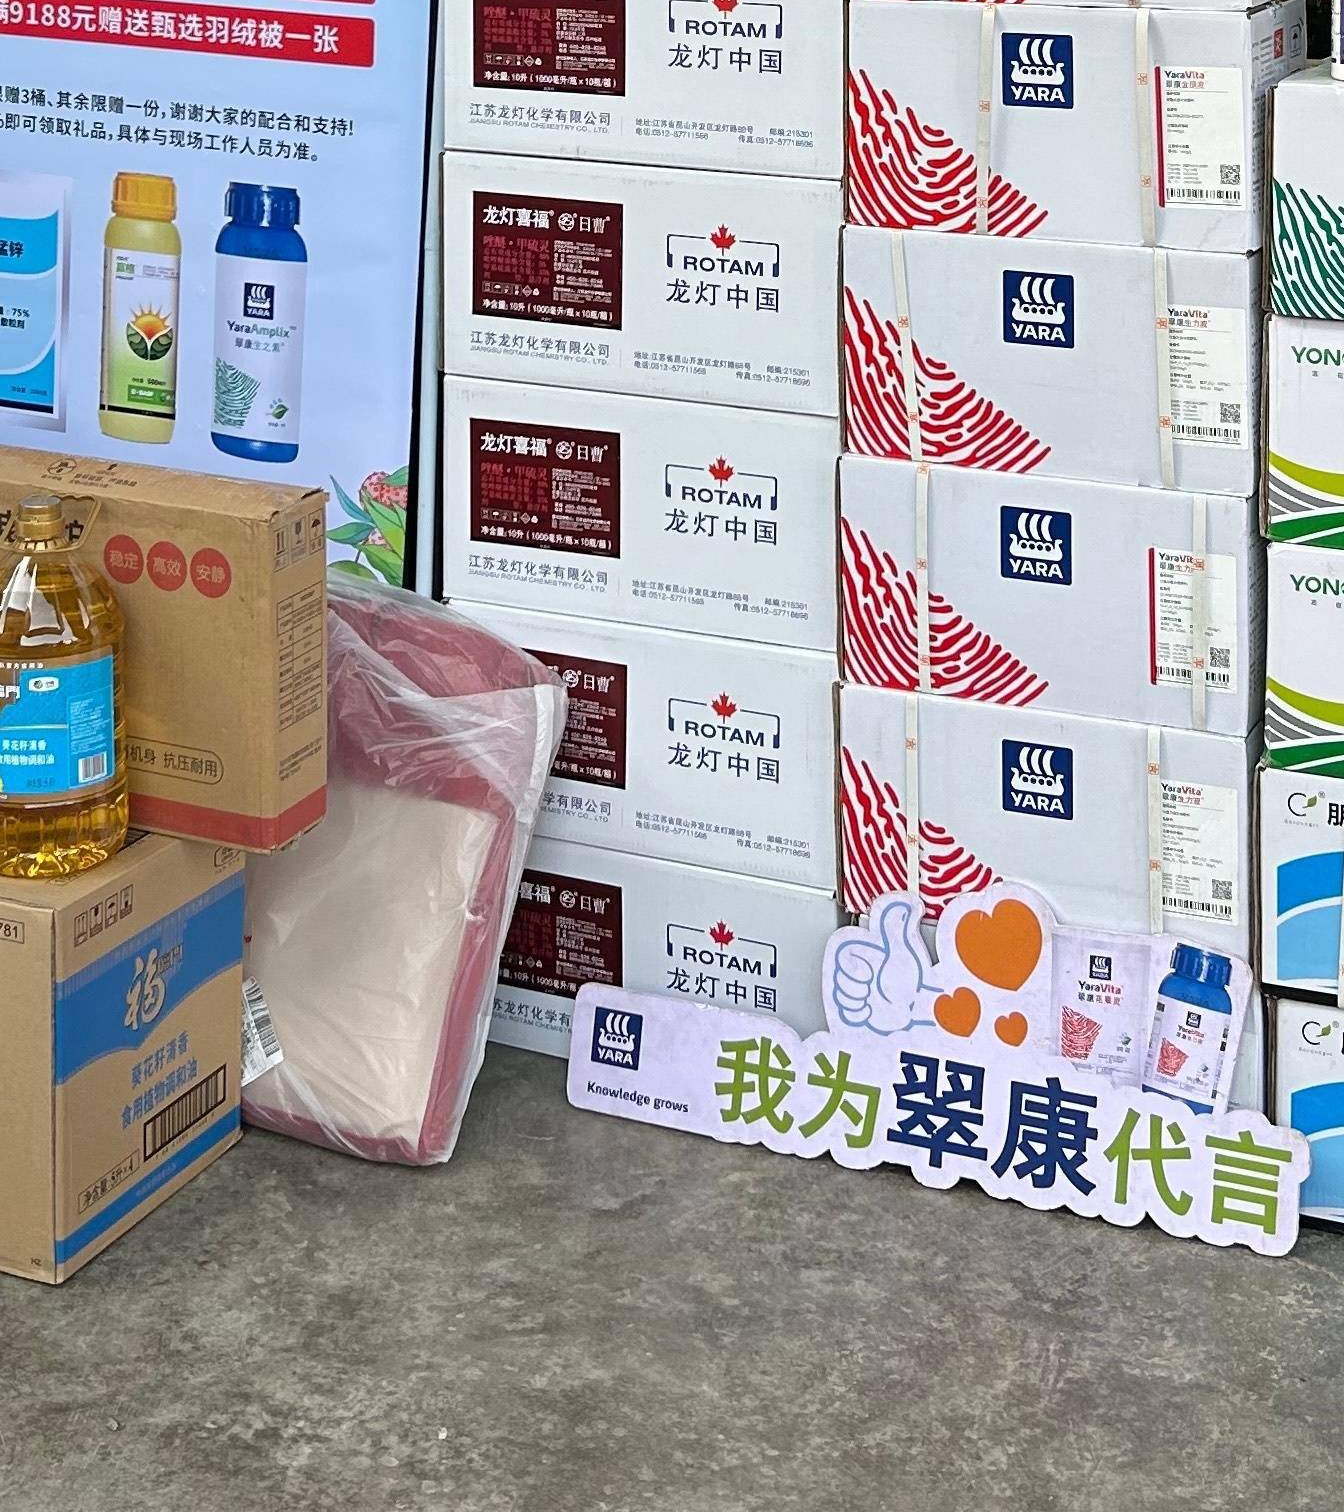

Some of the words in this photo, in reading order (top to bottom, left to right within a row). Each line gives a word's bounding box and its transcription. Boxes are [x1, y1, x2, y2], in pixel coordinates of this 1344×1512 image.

[685, 19, 767, 39] ROTAM
[668, 43, 783, 74] 龙灯中国
[1164, 70, 1205, 81] YaraVita
[1010, 85, 1064, 103] YARA
[469, 102, 611, 126] 江苏龙灯化学有限公司
[483, 205, 550, 229] 龙灯喜福
[683, 256, 764, 277] ROTAM
[666, 279, 780, 312] 龙灯中国
[244, 308, 271, 317] YARA
[1167, 308, 1209, 319] YaraVita
[226, 319, 290, 339] YaraAmplix
[1012, 323, 1065, 342] YARA
[470, 330, 610, 358] 江苏龙灯化学有限公司
[480, 432, 547, 458] 龙灯喜福
[681, 486, 762, 510] ROTAM
[664, 509, 777, 545] 龙灯中国
[108, 549, 140, 572] 稳定
[151, 556, 182, 579] 高效
[468, 554, 609, 586] 江苏龙灯化学有限公司
[1009, 558, 1063, 579] YARA
[196, 563, 225, 586] 安静
[2, 738, 47, 751] 葵花籽清香
[685, 719, 765, 746] ROTAM
[163, 750, 218, 777] 抗压耐用
[667, 743, 780, 783] 龙灯中国
[1161, 782, 1204, 797] YaraVita
[1011, 789, 1063, 815] YARA
[682, 944, 763, 977] ROTAM
[666, 967, 778, 1010] 龙灯中国
[1078, 981, 1123, 995] YaraVita
[130, 1030, 189, 1086] 葵花籽清香
[597, 1048, 634, 1067] YARA
[122, 1058, 198, 1128] 食用植物调和油
[587, 1081, 651, 1109] Knowledge
[654, 1096, 689, 1115] grows
[714, 1034, 1294, 1237] 我为翠康代言
